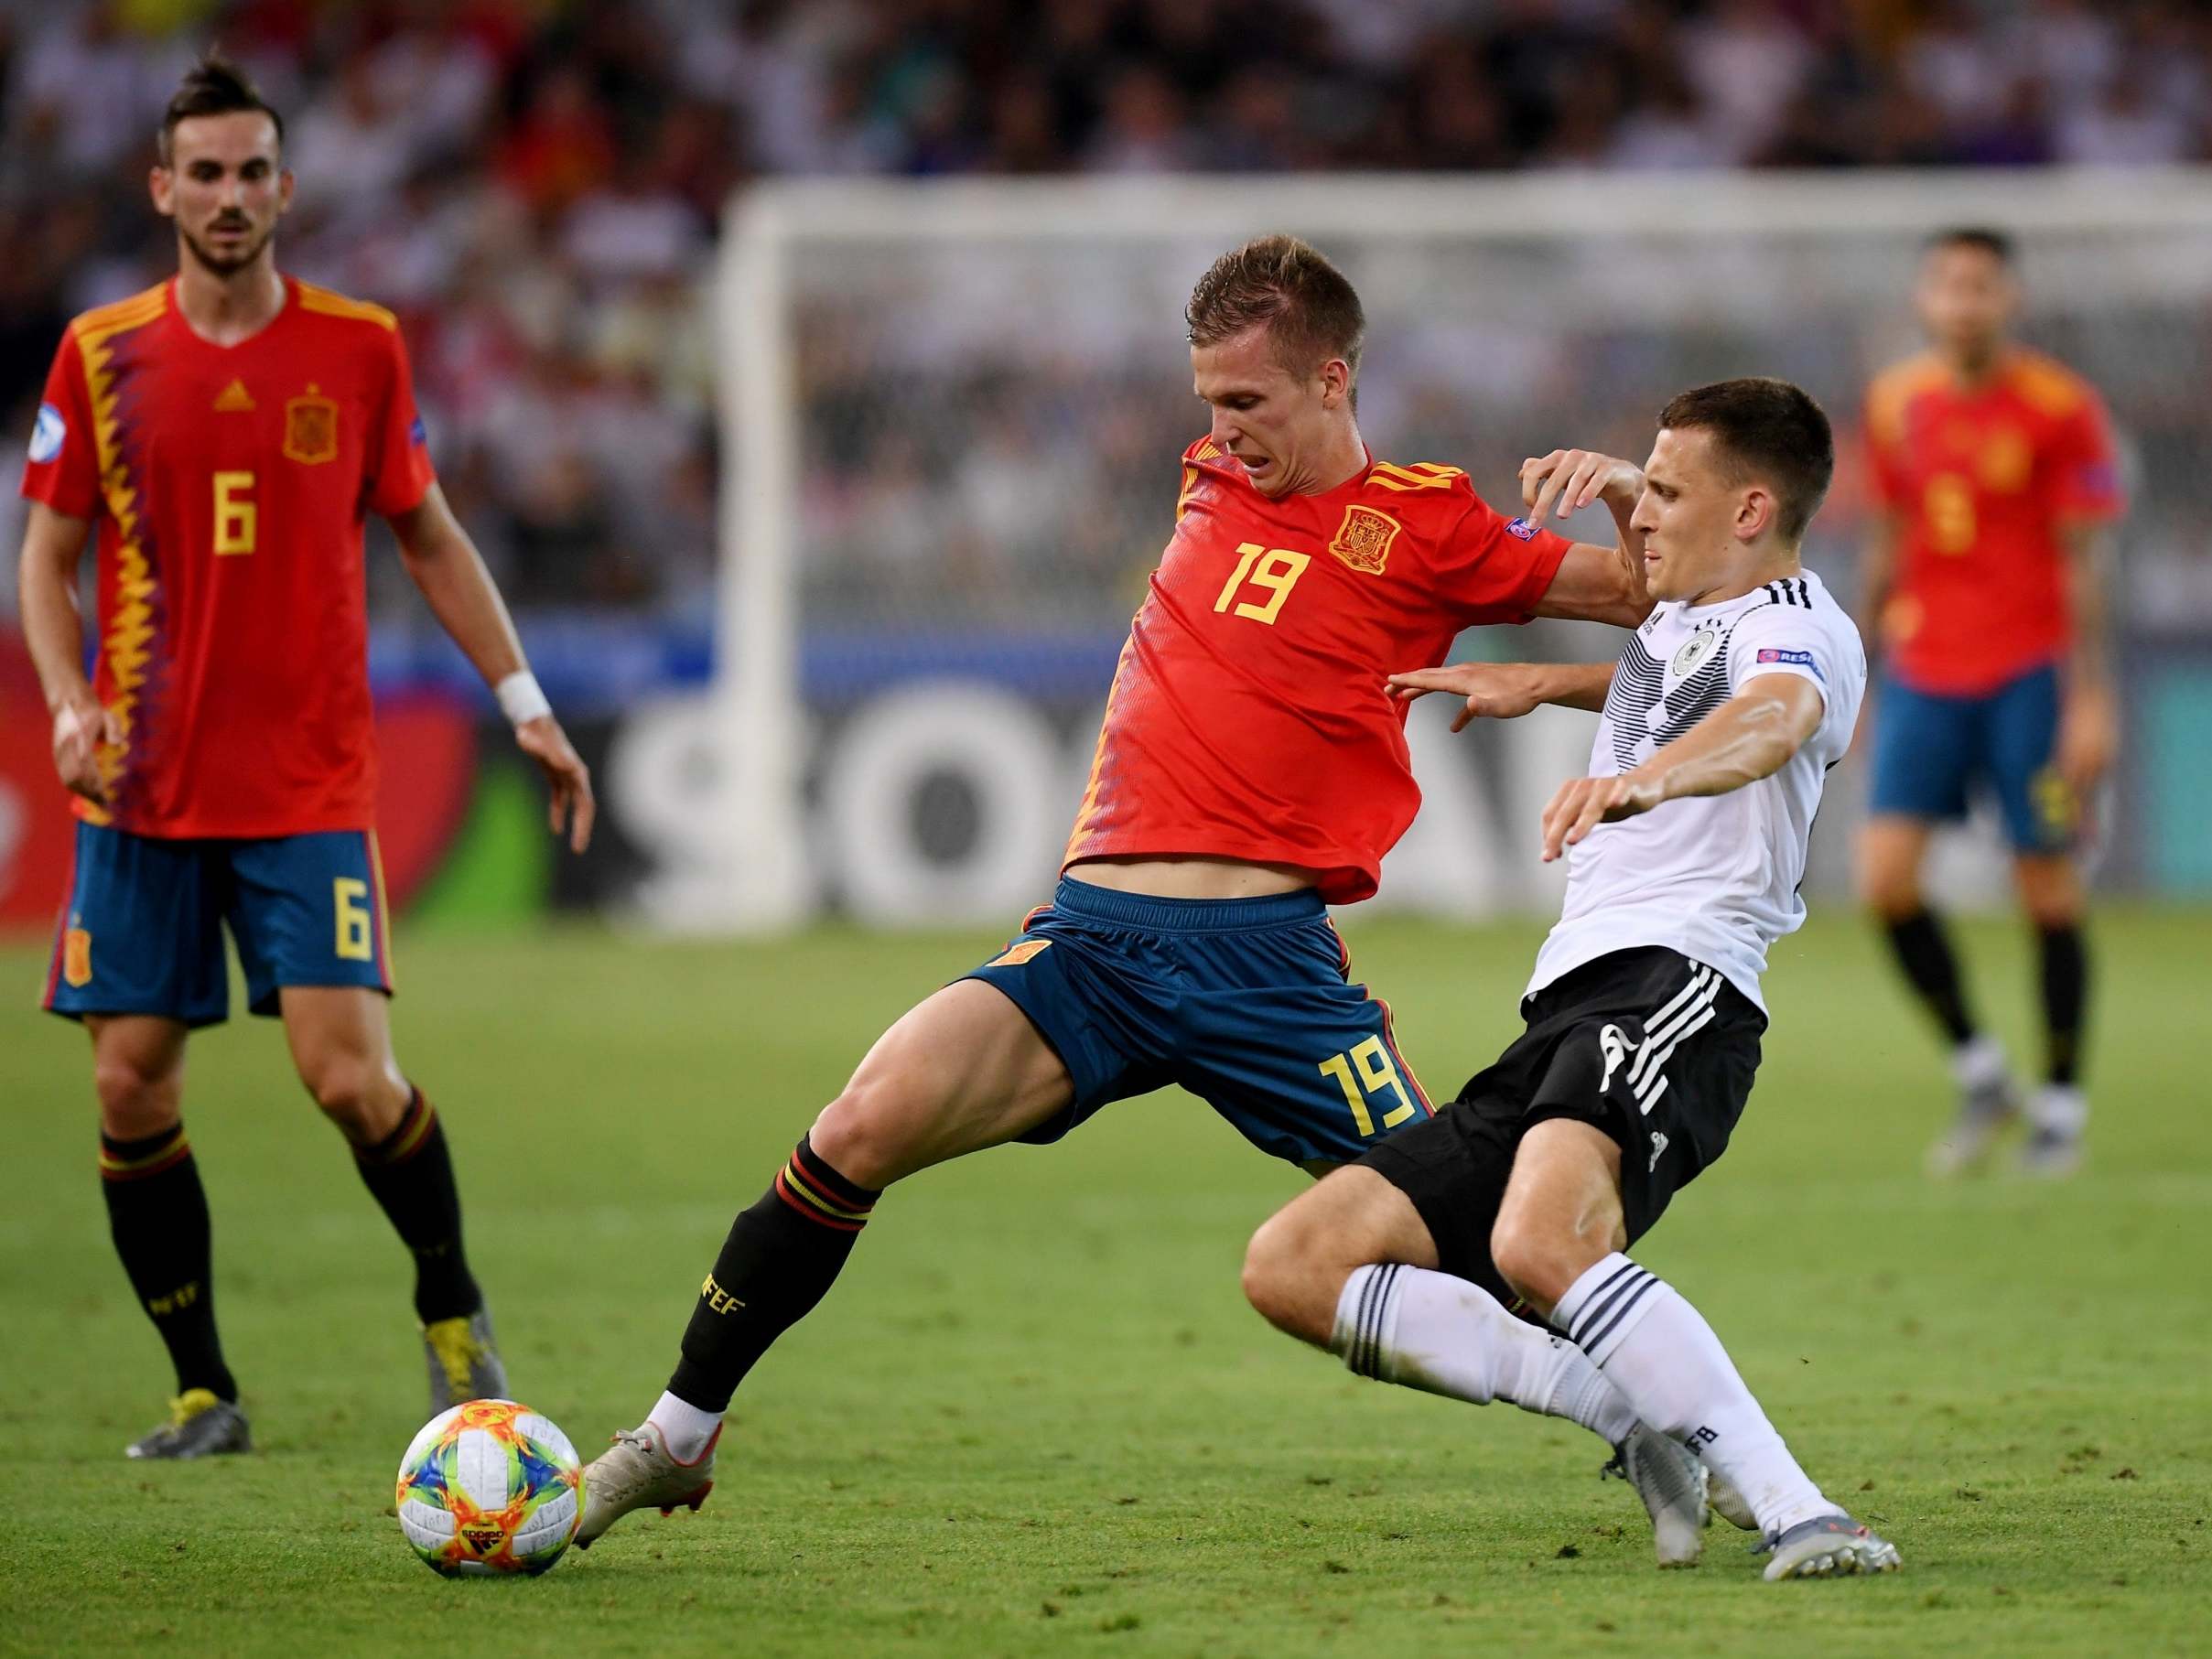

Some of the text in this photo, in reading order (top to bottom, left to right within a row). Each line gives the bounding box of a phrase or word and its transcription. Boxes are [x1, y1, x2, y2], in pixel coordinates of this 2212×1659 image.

[213, 470, 256, 556] 6
[1214, 542, 1311, 625] 19
[333, 877, 372, 961] 6
[1319, 1034, 1415, 1137] 19
